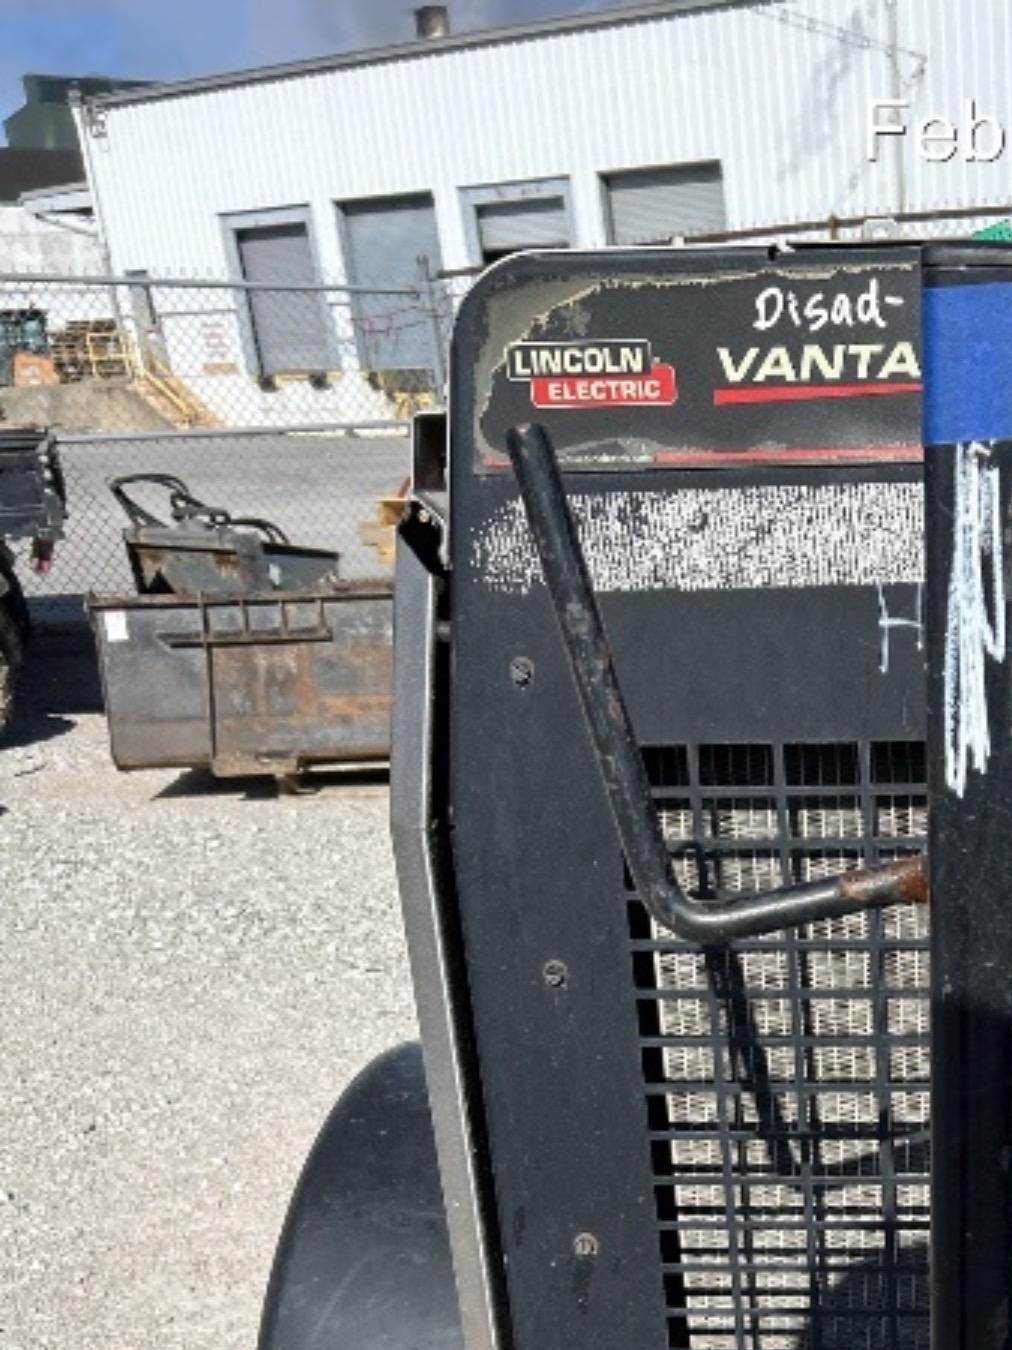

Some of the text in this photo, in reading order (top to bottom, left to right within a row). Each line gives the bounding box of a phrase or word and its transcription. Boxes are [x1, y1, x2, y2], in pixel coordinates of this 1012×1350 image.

[752, 277, 904, 331] Disad-
[514, 347, 643, 376] LINCOLN
[548, 379, 662, 401] ELECTRIC
